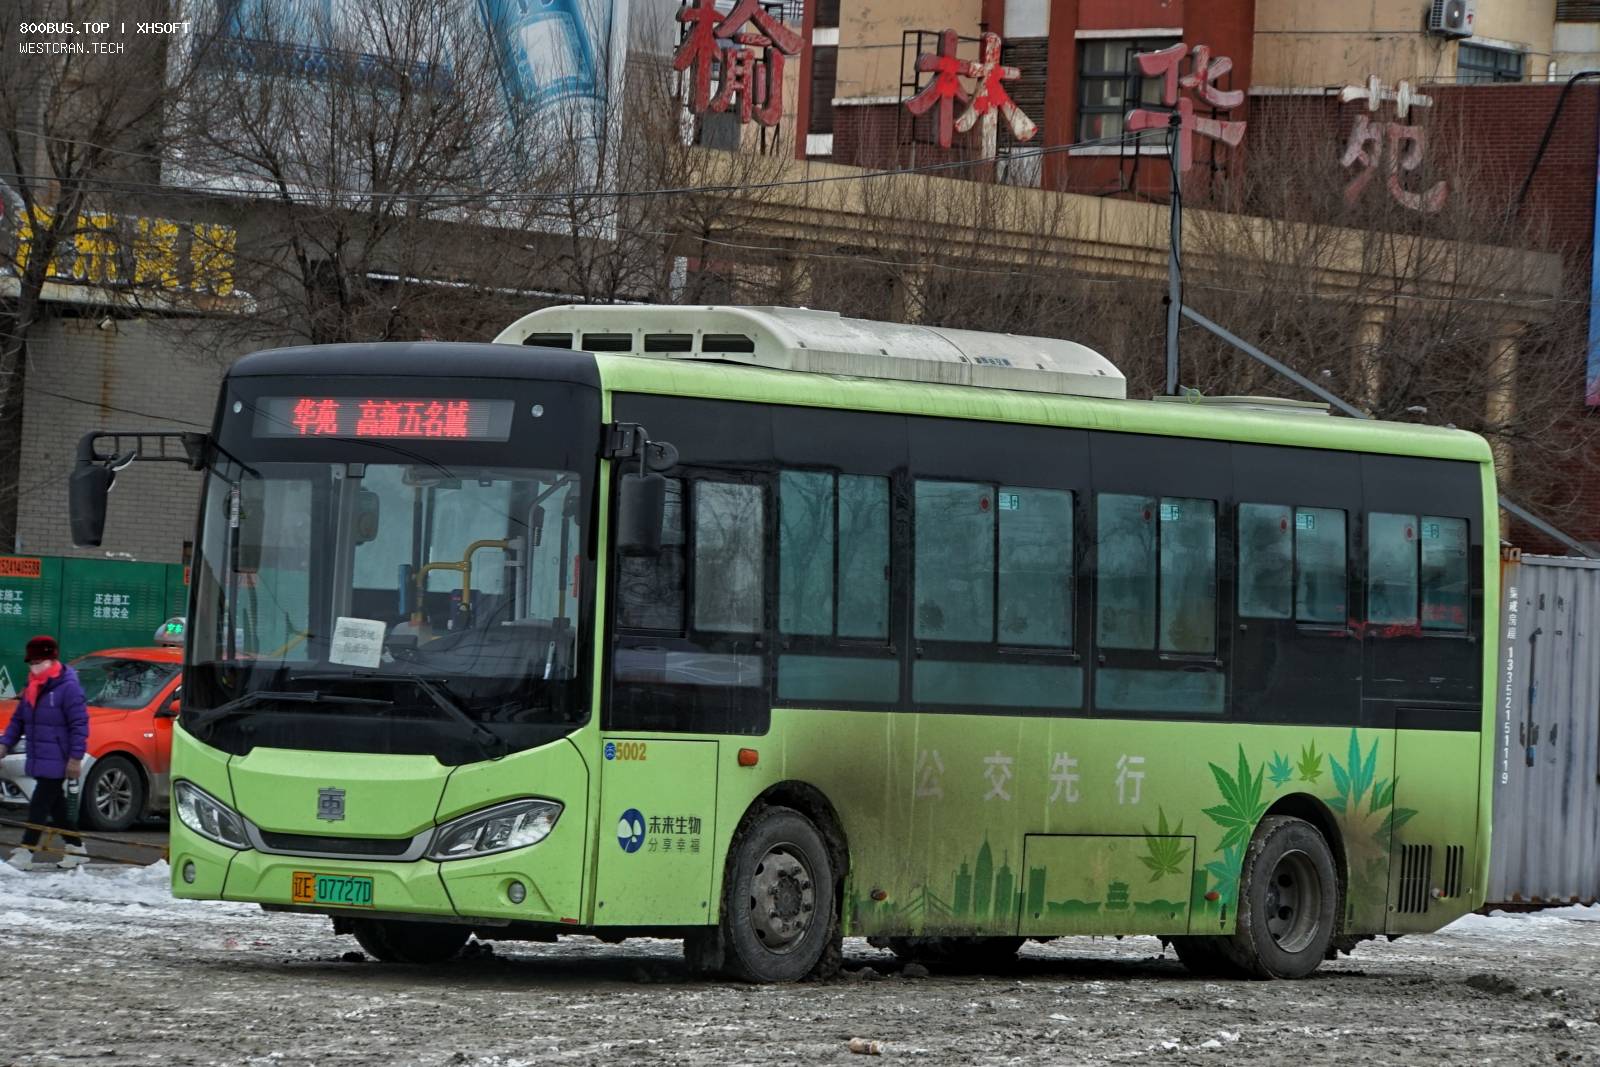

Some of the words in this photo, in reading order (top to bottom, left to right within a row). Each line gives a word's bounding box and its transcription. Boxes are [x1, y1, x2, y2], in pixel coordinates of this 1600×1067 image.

[673, 0, 1448, 213] 榆林华苑
[94, 593, 131, 606] 正在施工
[93, 606, 129, 619] 注意安全
[616, 742, 647, 761] 5002
[915, 750, 1145, 805] 公交先行
[648, 815, 702, 835] 未来生物
[648, 838, 701, 853] 分享幸福
